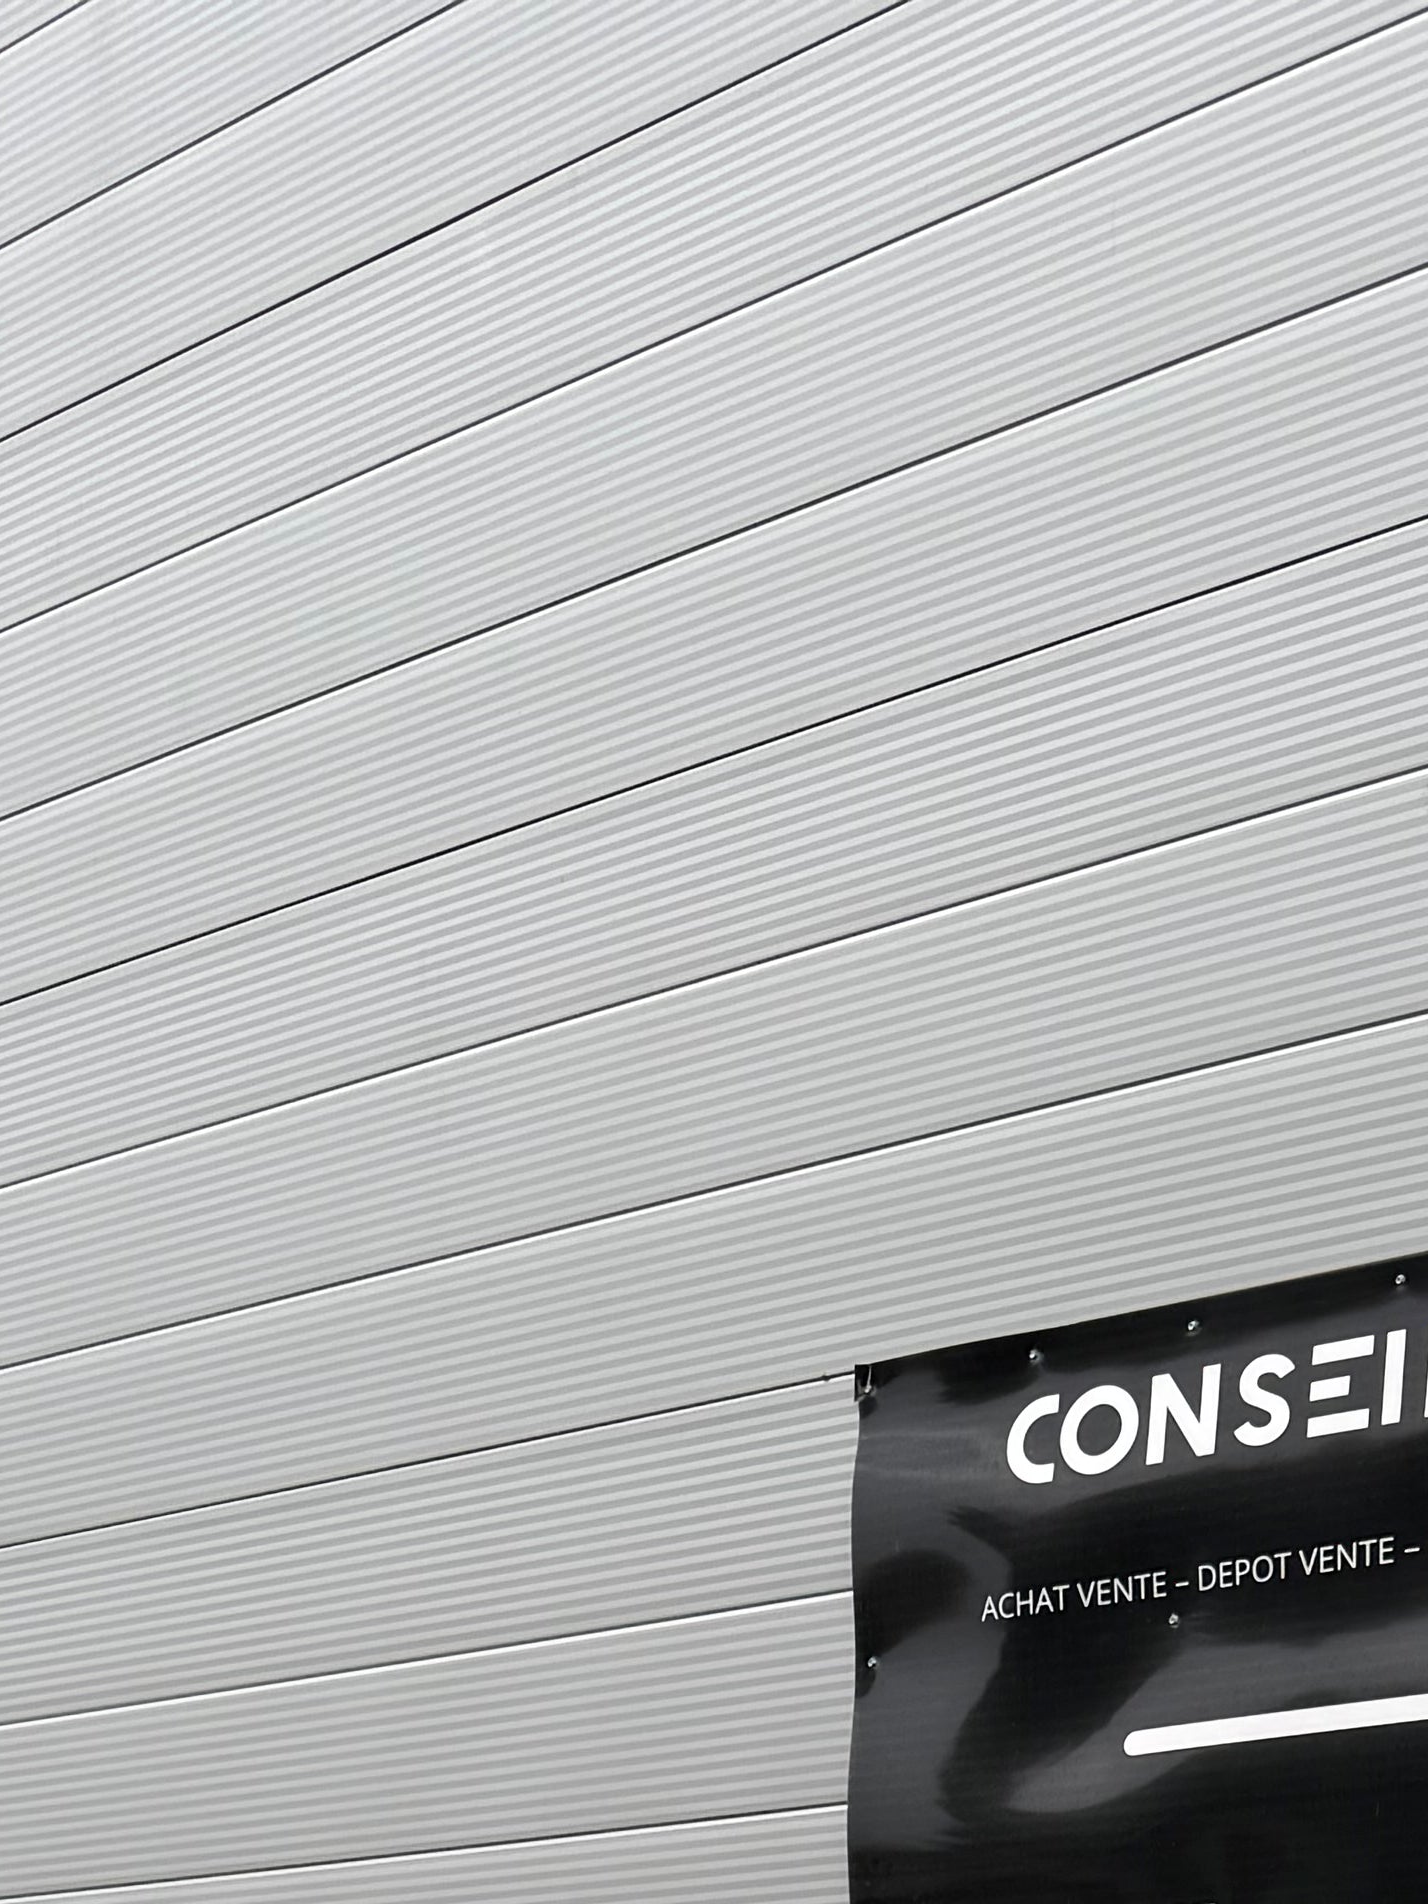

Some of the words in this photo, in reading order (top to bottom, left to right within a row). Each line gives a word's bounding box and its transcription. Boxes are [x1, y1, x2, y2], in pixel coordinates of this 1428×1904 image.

[981, 1584, 1070, 1622] ACHAT
[1076, 1571, 1168, 1608] VENTE
[1197, 1551, 1292, 1592] DEPOT
[1298, 1536, 1395, 1576] VENTE
